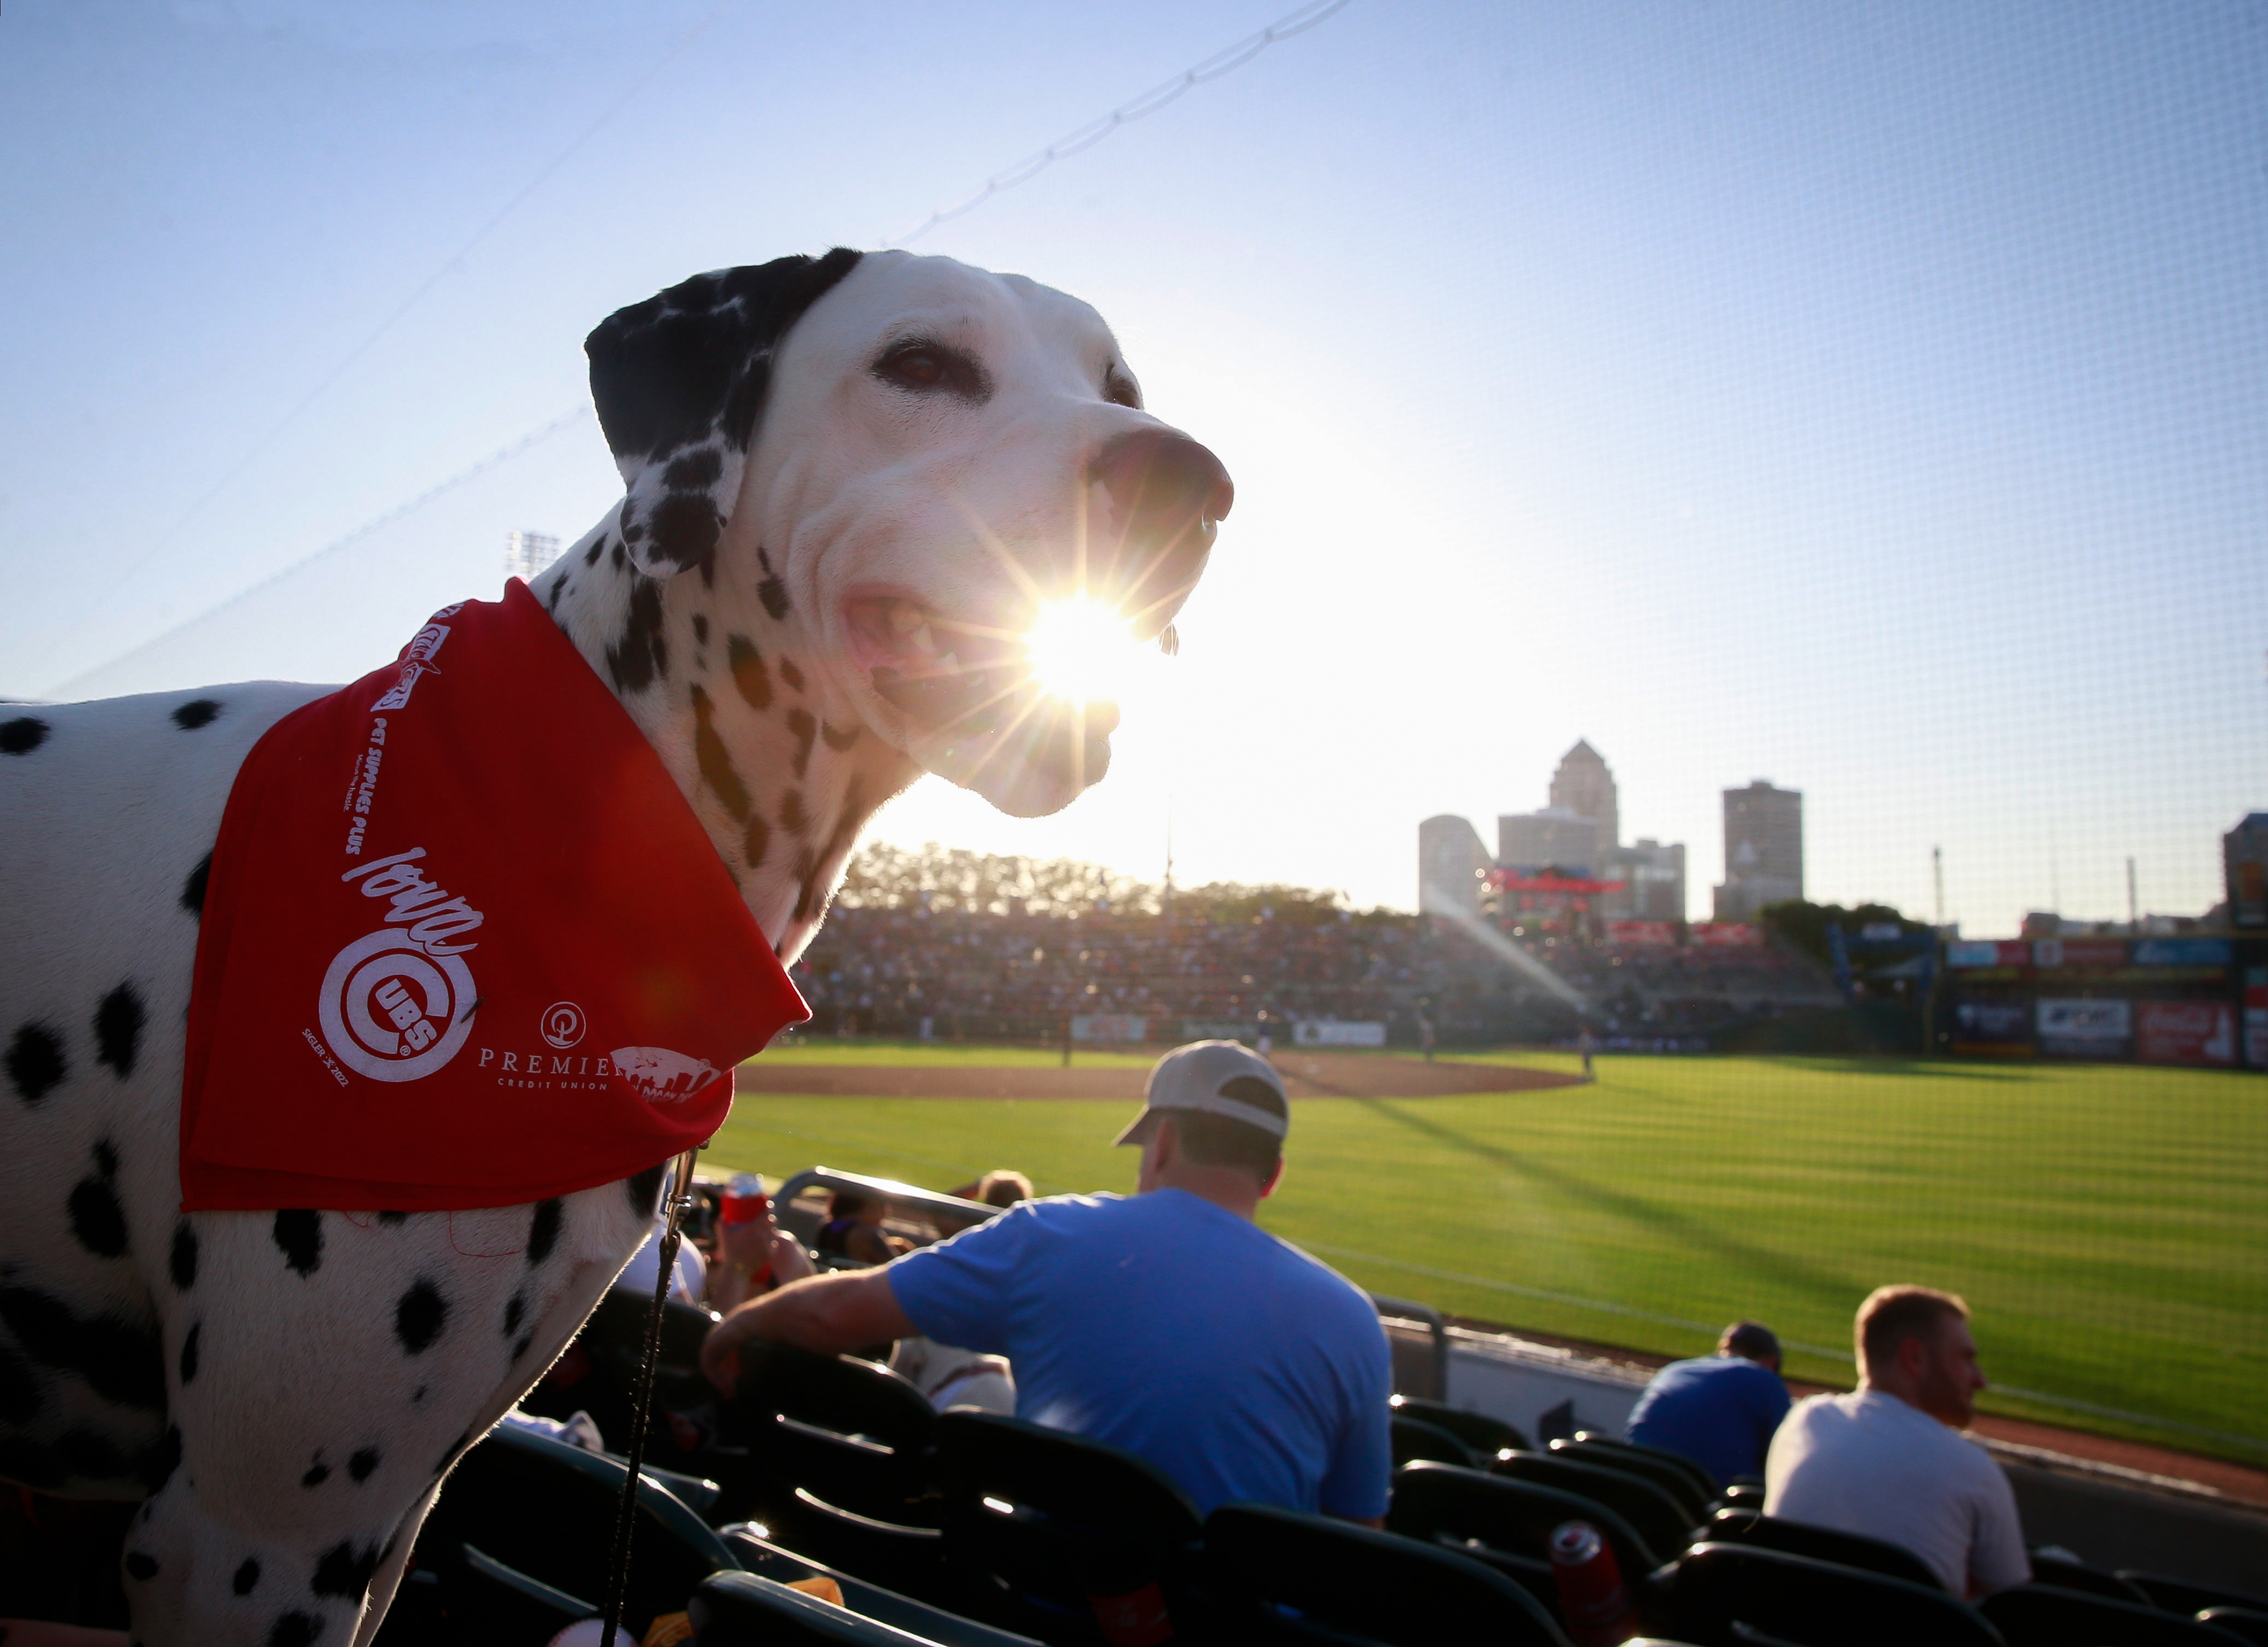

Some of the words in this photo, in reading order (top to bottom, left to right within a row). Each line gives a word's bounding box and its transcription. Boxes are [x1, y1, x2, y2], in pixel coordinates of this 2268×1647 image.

[370, 717, 387, 746] PET
[355, 747, 383, 815] SUPPLIES
[343, 787, 356, 812] hassle.
[346, 816, 367, 855] PLUS
[302, 1028, 325, 1057] SIGLER
[330, 1065, 349, 1088] 2022
[497, 1078, 550, 1089] CREDIT
[561, 1082, 607, 1091] UNION
